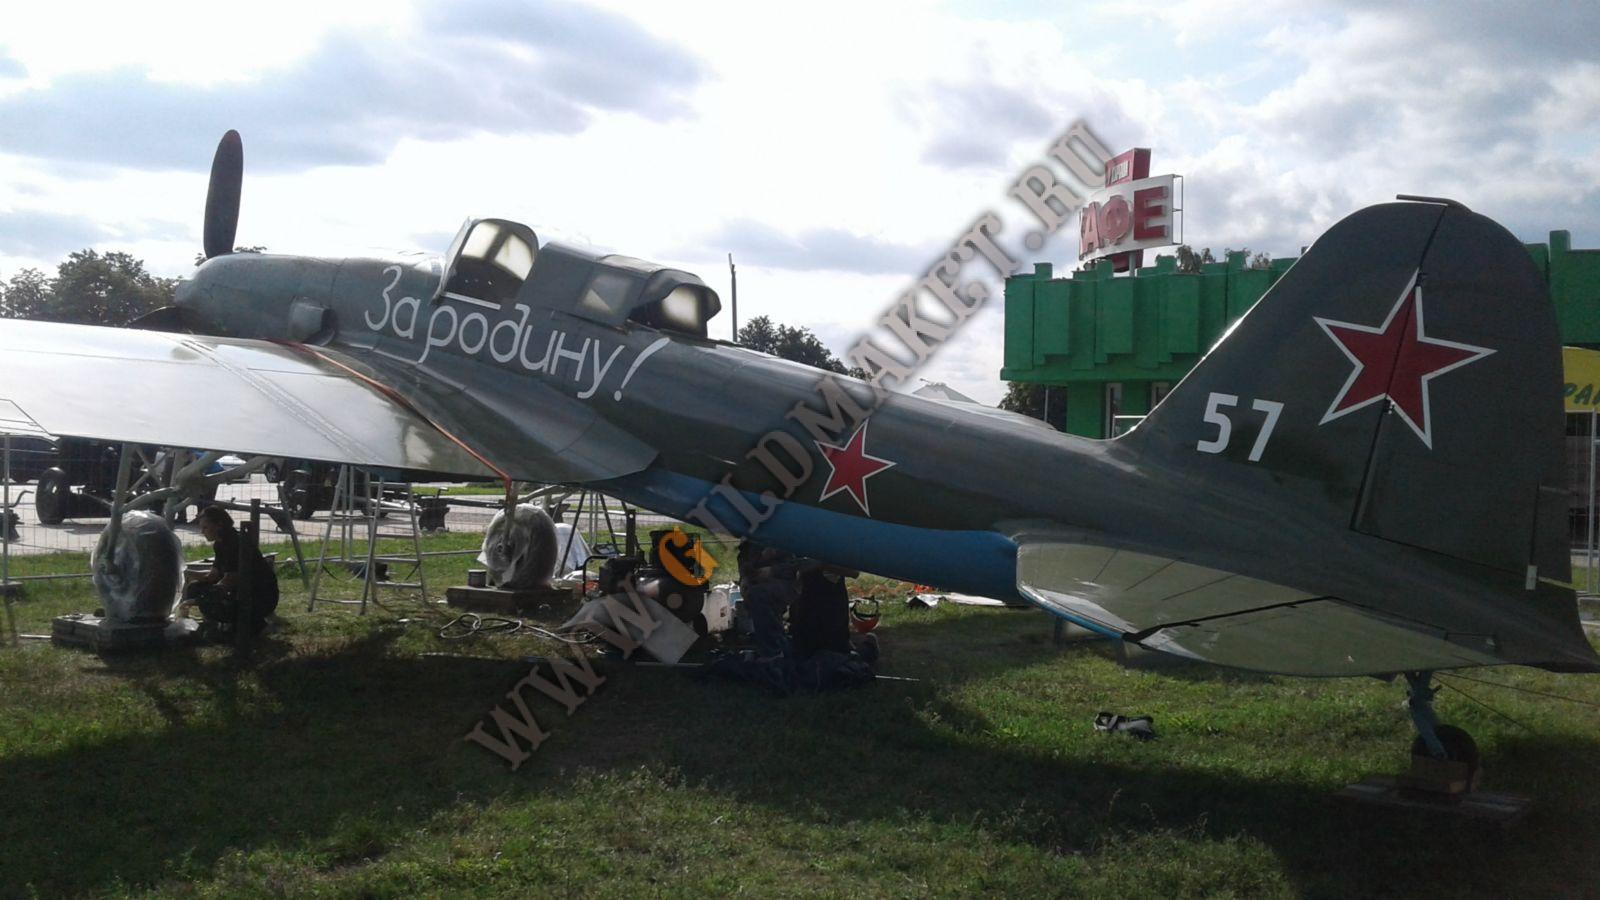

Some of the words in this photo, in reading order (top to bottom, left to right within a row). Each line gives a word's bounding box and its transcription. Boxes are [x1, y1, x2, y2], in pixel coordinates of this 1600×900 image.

[364, 265, 421, 339] За
[417, 303, 671, 402] родину!
[1196, 391, 1285, 462] 57
